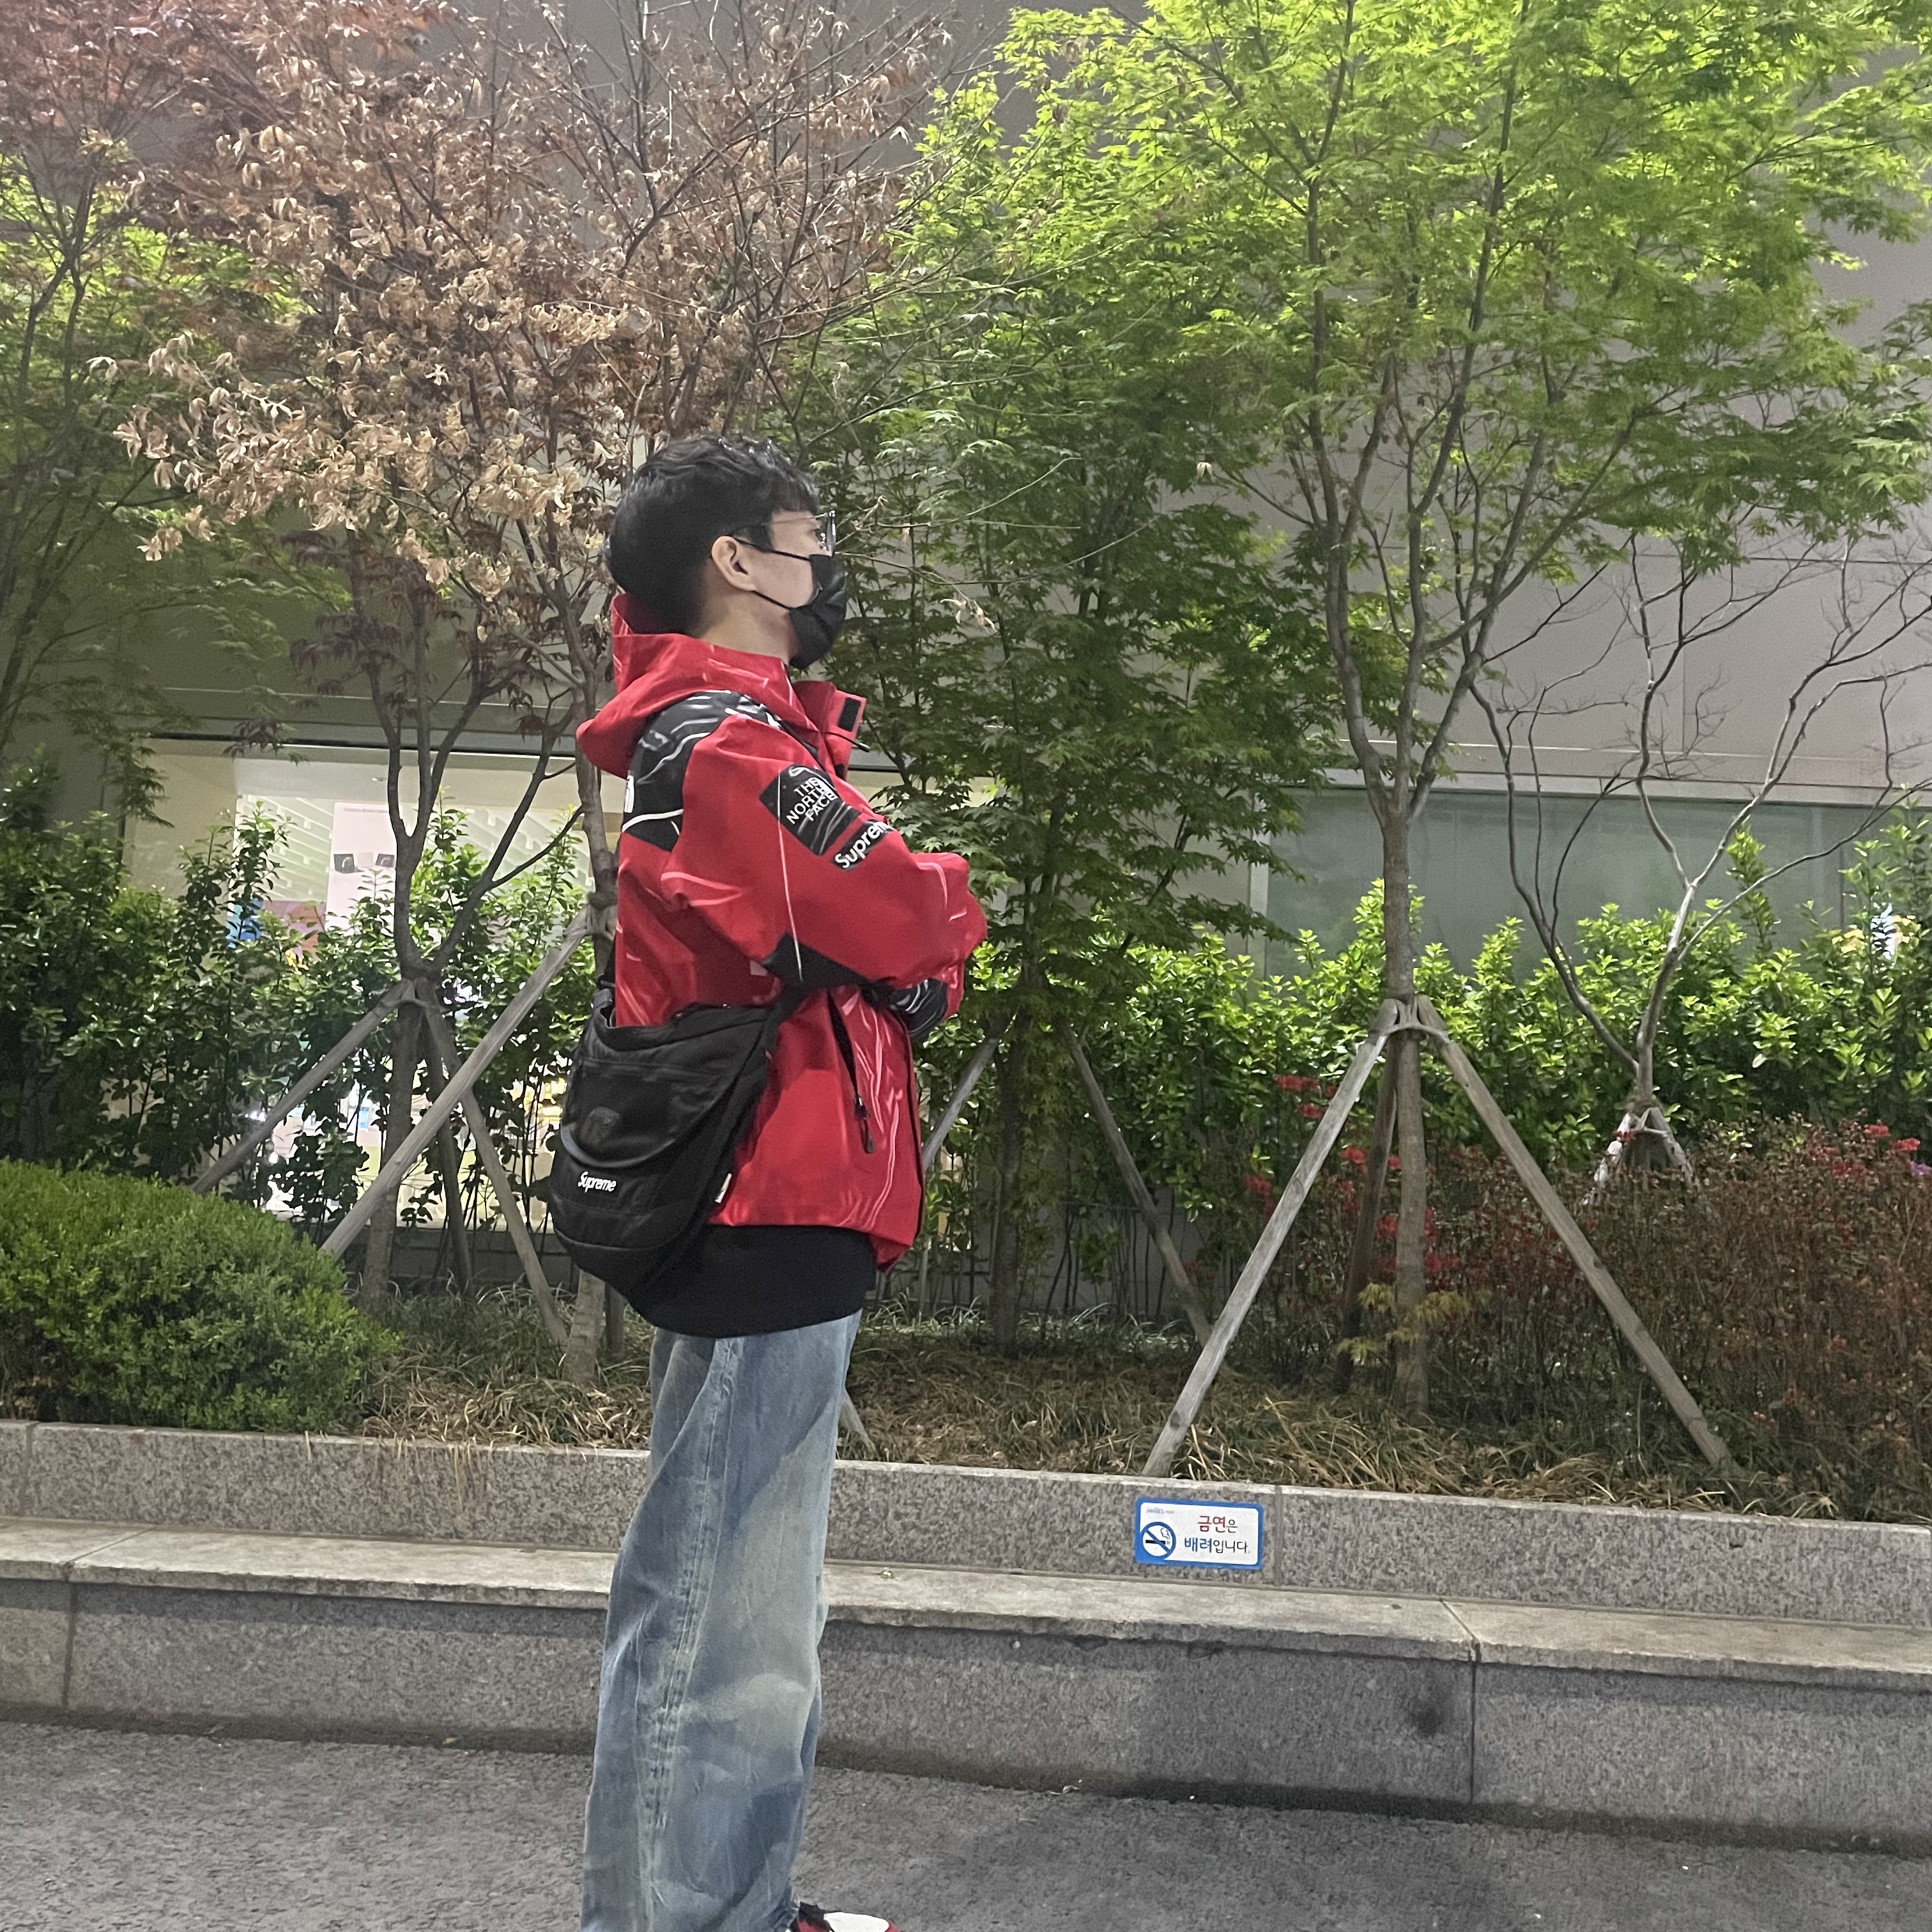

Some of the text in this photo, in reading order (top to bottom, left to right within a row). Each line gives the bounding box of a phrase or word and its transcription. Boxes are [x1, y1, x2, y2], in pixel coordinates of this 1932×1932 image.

[794, 778, 818, 797] THE
[786, 784, 828, 825] NORTH
[805, 791, 838, 822] FACE
[835, 822, 896, 868] Suprem
[578, 1171, 617, 1193] Supreme
[1197, 1515, 1238, 1534] 금연은
[1184, 1537, 1251, 1554] 배려입니다.
